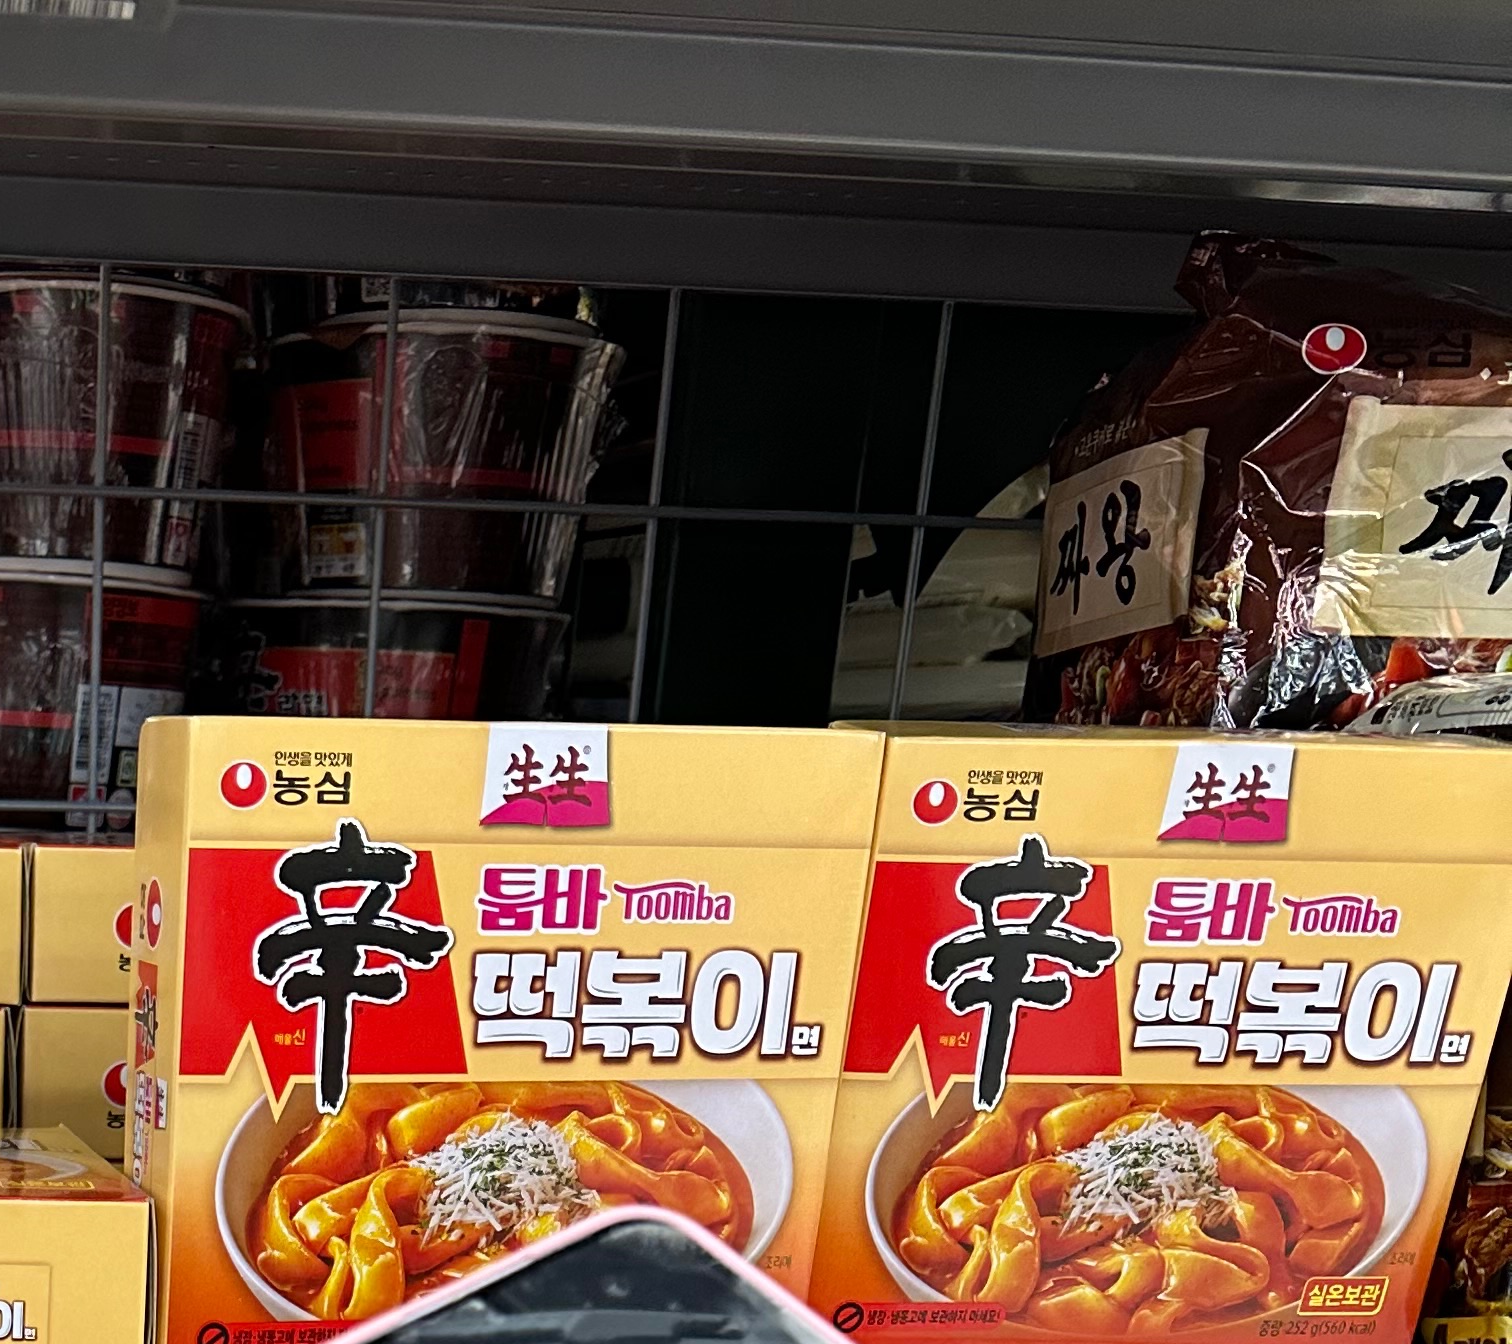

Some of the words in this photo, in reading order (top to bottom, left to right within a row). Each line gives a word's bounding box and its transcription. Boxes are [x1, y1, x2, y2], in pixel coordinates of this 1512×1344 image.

[1050, 479, 1151, 618] 짜왕
[273, 770, 351, 805] 농심
[274, 751, 312, 765] 인생을
[314, 752, 352, 766] 맛있게
[504, 744, 593, 808] 生生
[967, 770, 1004, 784] 인생을
[1007, 771, 1043, 786] 맛있게
[963, 789, 1040, 822] 농심
[1184, 763, 1272, 823] 生生
[478, 868, 607, 932] 툼바
[614, 881, 731, 923] Toomba
[1148, 882, 1275, 942] 툼바
[1283, 896, 1398, 935] Toomba
[255, 820, 452, 1113] 辛
[928, 836, 1121, 1109] 辛
[1308, 1285, 1380, 1307] 실온보관
[1285, 1321, 1307, 1335] 252
[1348, 1321, 1376, 1335] kcal)
